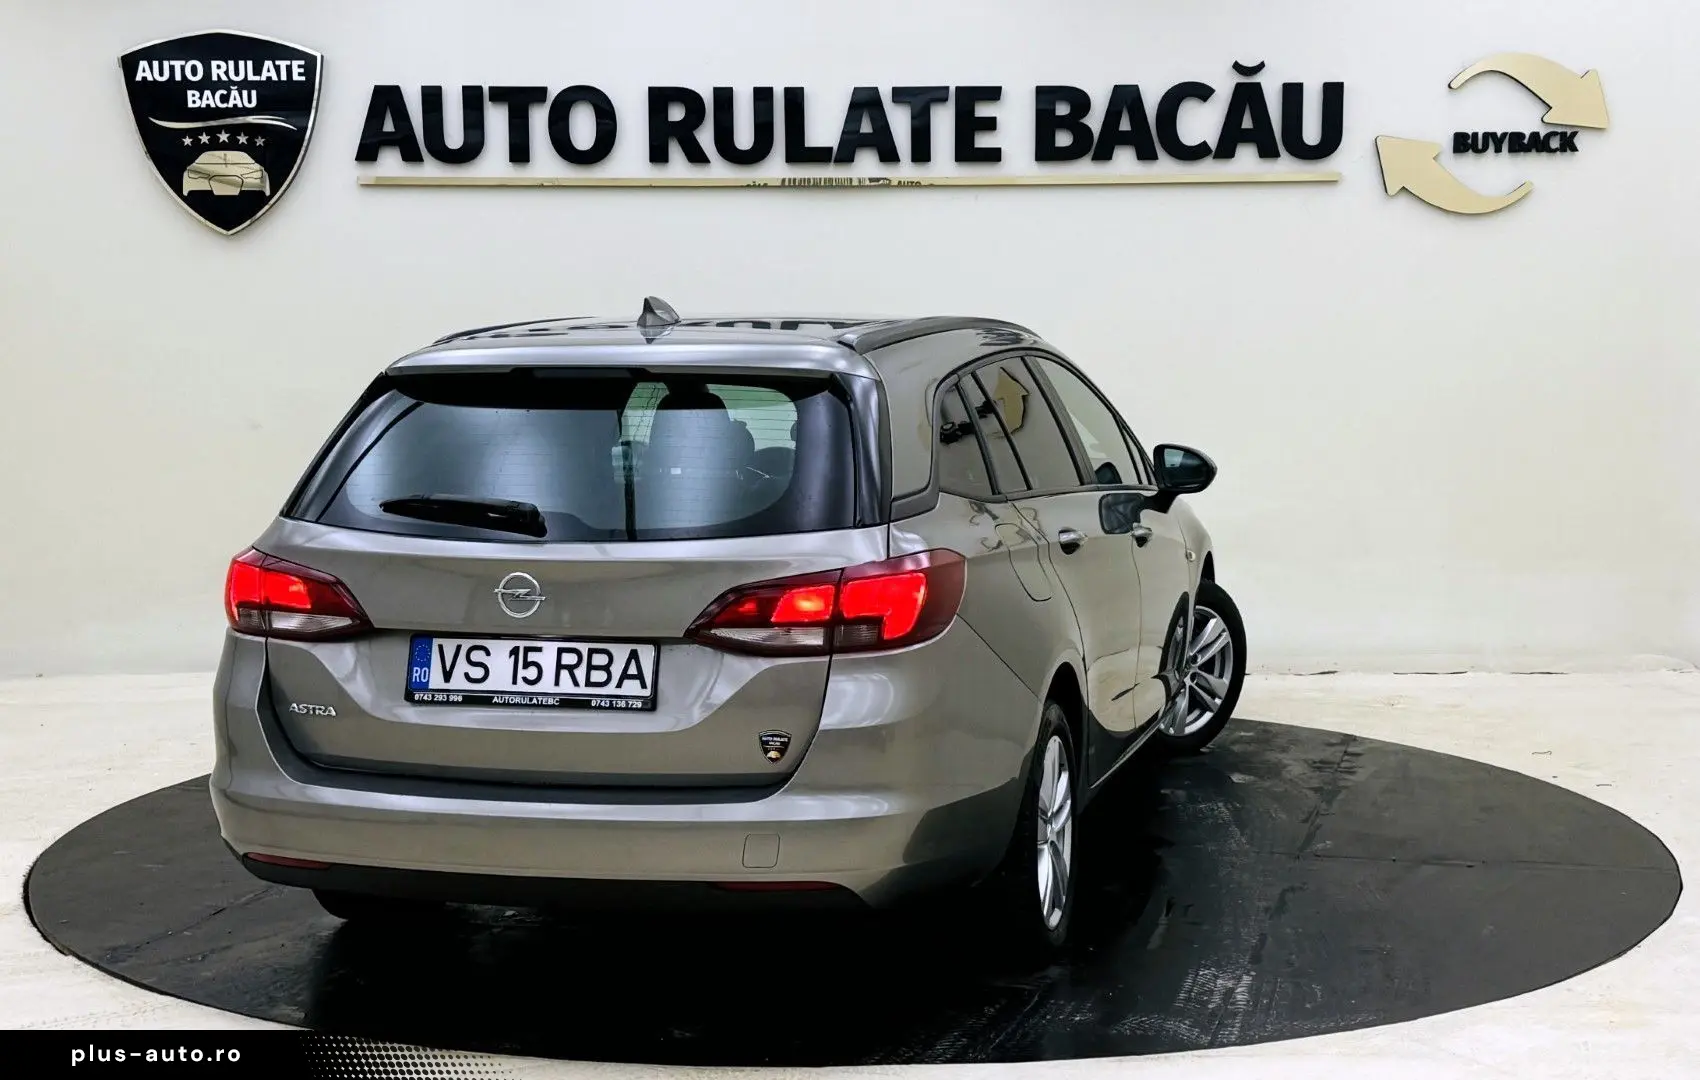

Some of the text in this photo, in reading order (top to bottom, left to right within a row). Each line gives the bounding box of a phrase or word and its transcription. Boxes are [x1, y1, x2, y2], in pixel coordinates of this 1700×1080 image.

[135, 60, 306, 81] AUTO RULATE
[186, 86, 257, 108] BACĂU
[355, 60, 1345, 165] AUTO RULATE BACĂU
[1452, 131, 1580, 154] BUYBACK
[412, 667, 429, 683] RO
[437, 644, 649, 690] VS 15 RBA
[414, 693, 432, 701] 0743
[492, 696, 560, 705] AUTORULATEBC
[591, 699, 610, 707] 0743
[628, 700, 643, 708] 729
[289, 703, 337, 717] ASTRA
